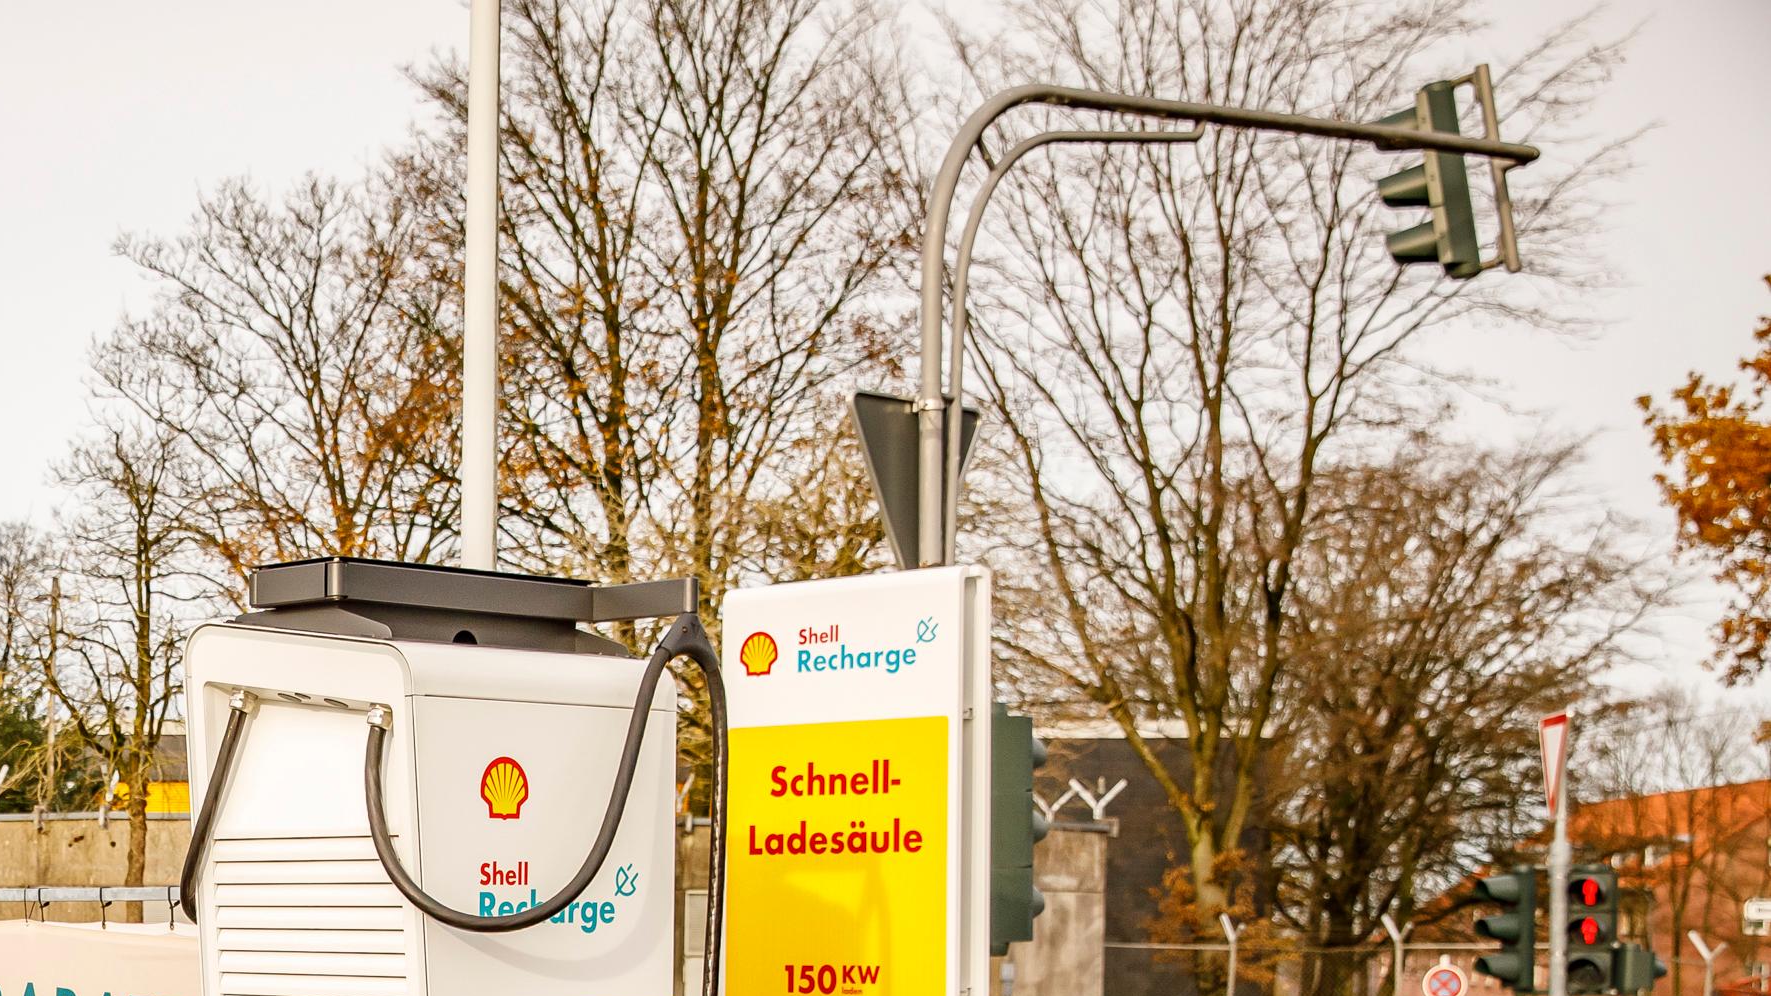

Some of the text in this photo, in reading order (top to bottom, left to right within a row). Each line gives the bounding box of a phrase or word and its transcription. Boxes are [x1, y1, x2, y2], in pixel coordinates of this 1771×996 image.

[798, 624, 839, 645] Shell
[797, 645, 917, 674] Recharge
[770, 759, 901, 798] Schnell-
[749, 818, 923, 855] Ladesäule
[479, 861, 529, 886] Shell
[784, 964, 881, 995] 150 KW
